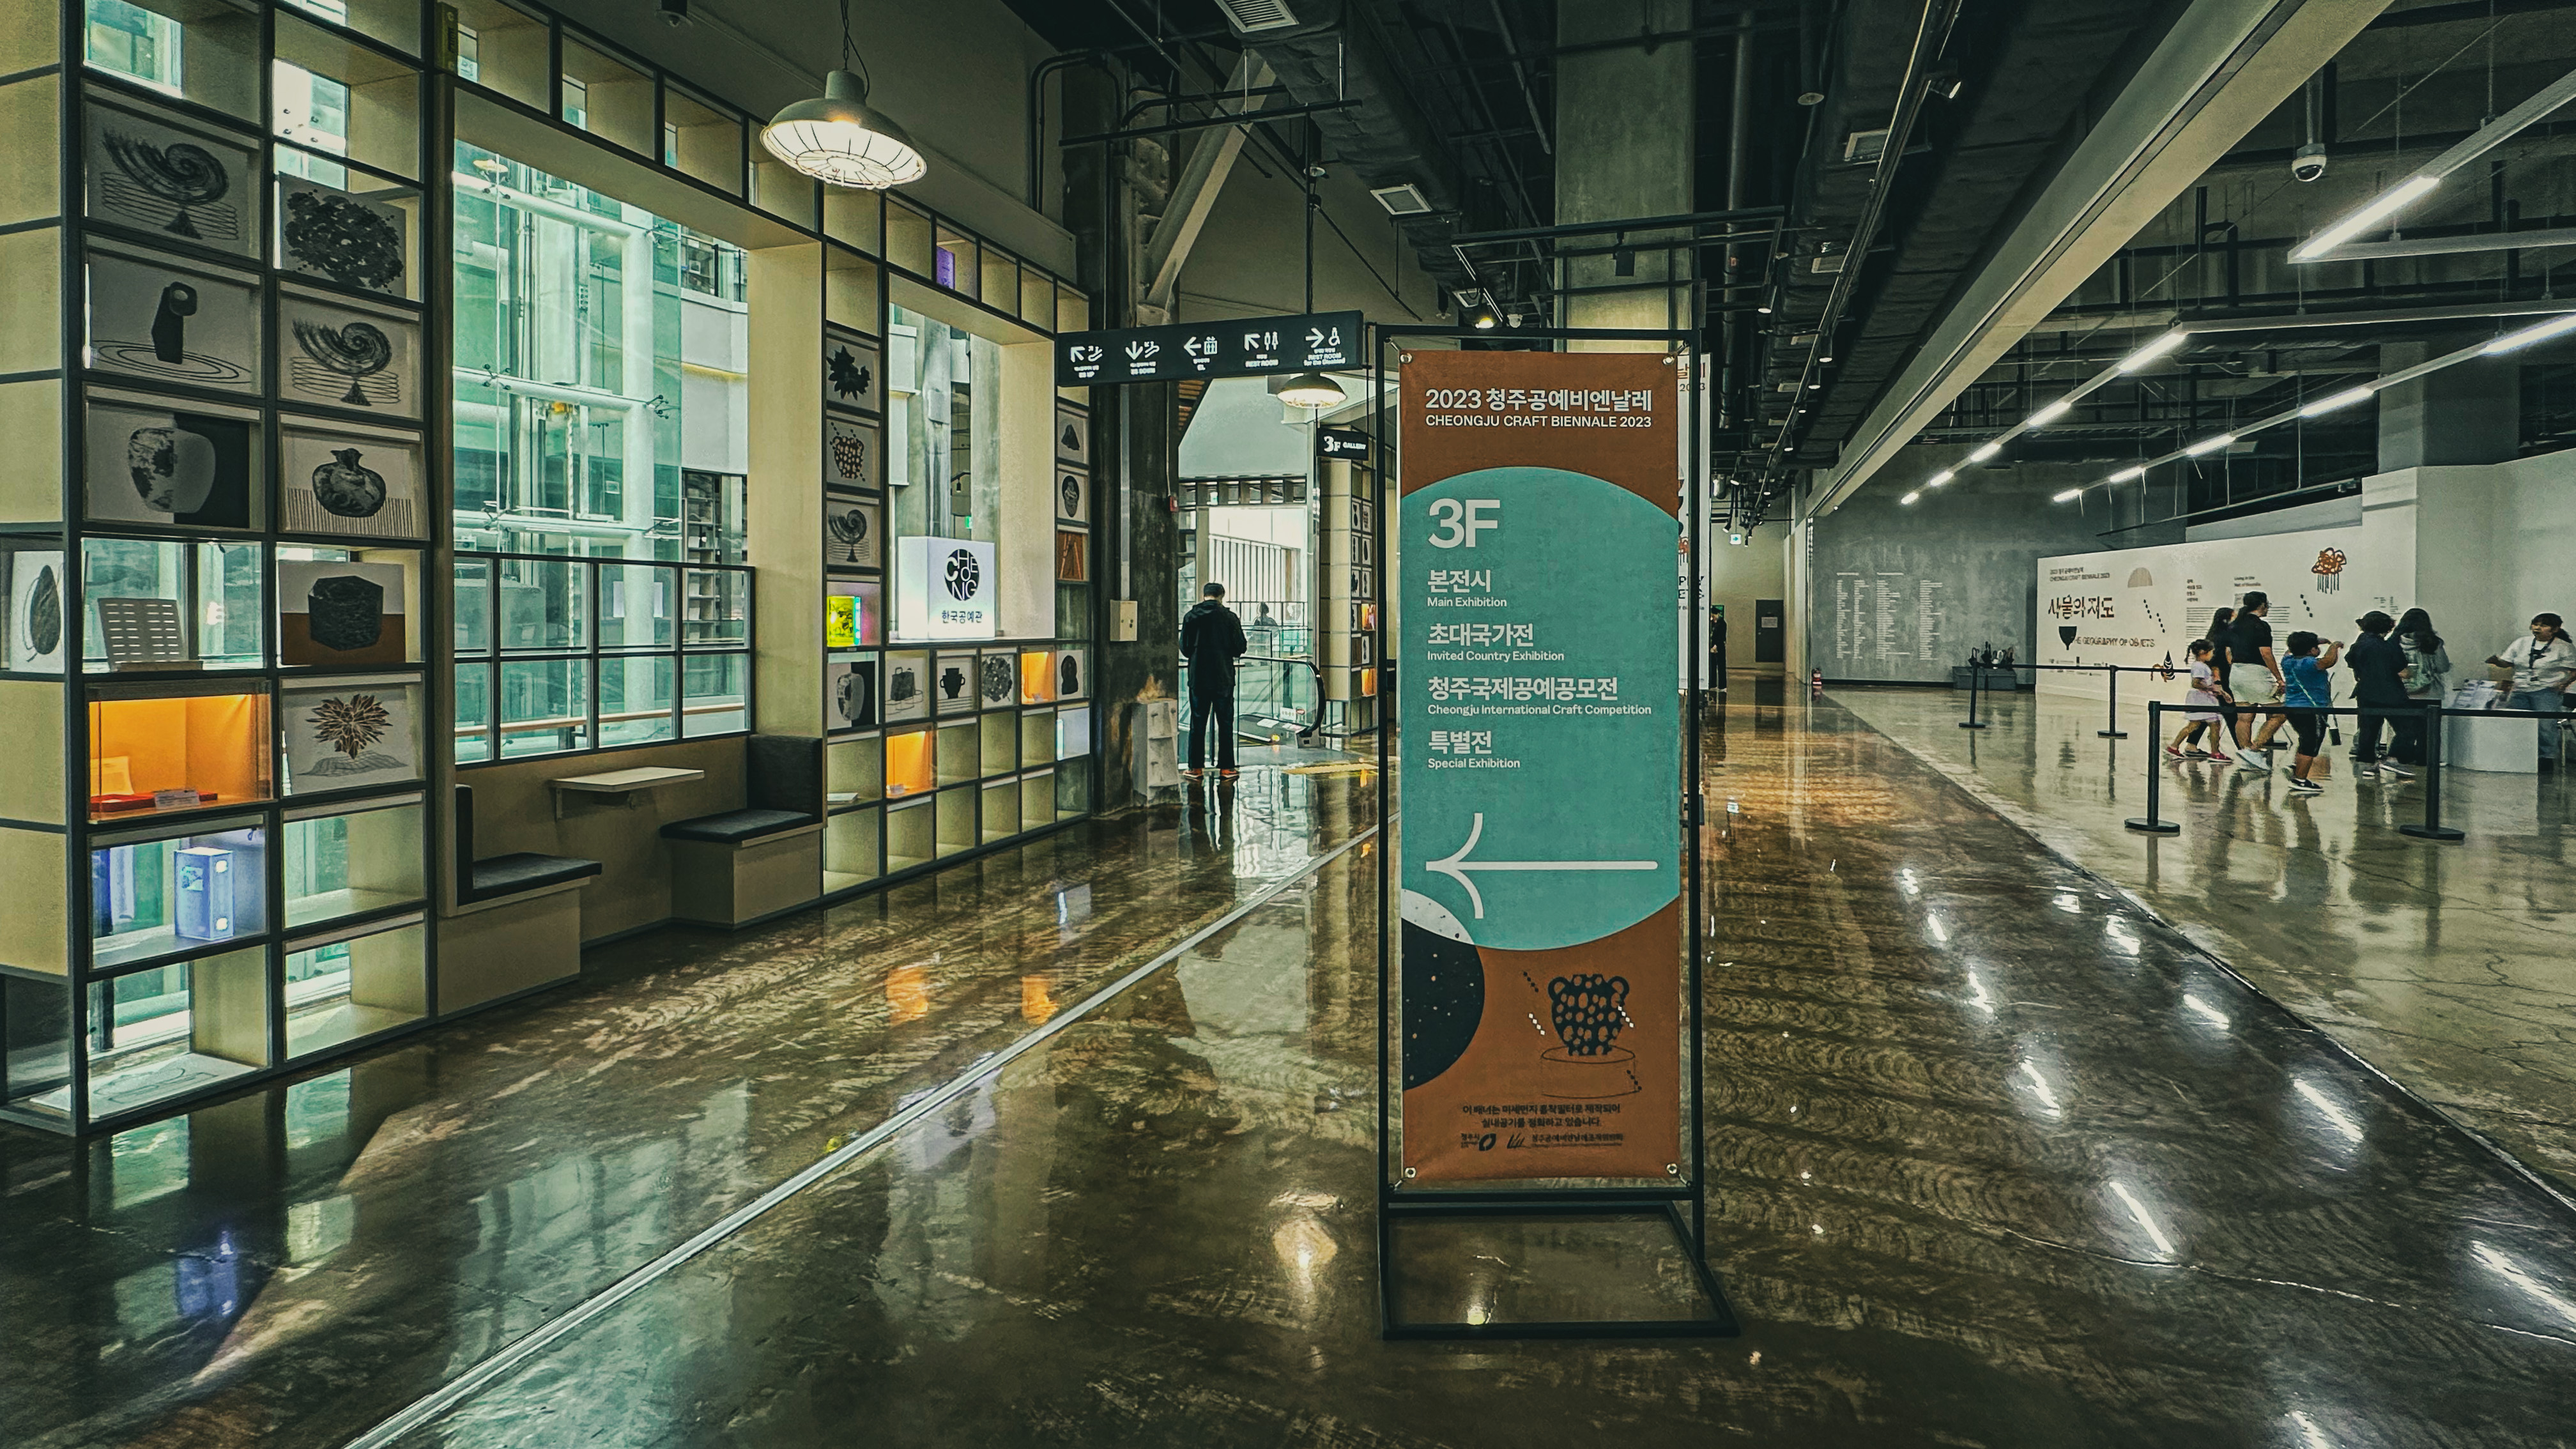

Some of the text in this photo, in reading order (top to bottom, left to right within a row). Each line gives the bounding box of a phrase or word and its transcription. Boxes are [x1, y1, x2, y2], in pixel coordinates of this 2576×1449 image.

[1426, 388, 1651, 411] 2023 청주공예비엔날레
[1426, 415, 1651, 427] CHEONGJU CRAFT BIENNALE 2023
[1324, 436, 1341, 452] 3F
[1429, 498, 1500, 548] 3F
[1428, 570, 1491, 593] 본전시
[1428, 597, 1506, 606] Main Exhibition
[2048, 595, 2114, 619] 사물의 지도
[942, 610, 983, 624] 한국공예관
[1428, 624, 1533, 647] 초대국가전
[1428, 650, 1564, 663] Invited Country Exhibition
[1429, 677, 1618, 700] 청주국제공예공모전
[1428, 704, 1651, 716] Cheongju International Craft Competition
[1429, 731, 1491, 754] 특별전
[1429, 758, 1520, 770] Special Exhibition
[1463, 1105, 1472, 1114] 이
[1473, 1105, 1500, 1115] 배너는
[1502, 1105, 1537, 1114] 미세먼지
[1585, 1104, 1620, 1114] 제작되어
[1482, 1117, 1524, 1128] 실내공기를
